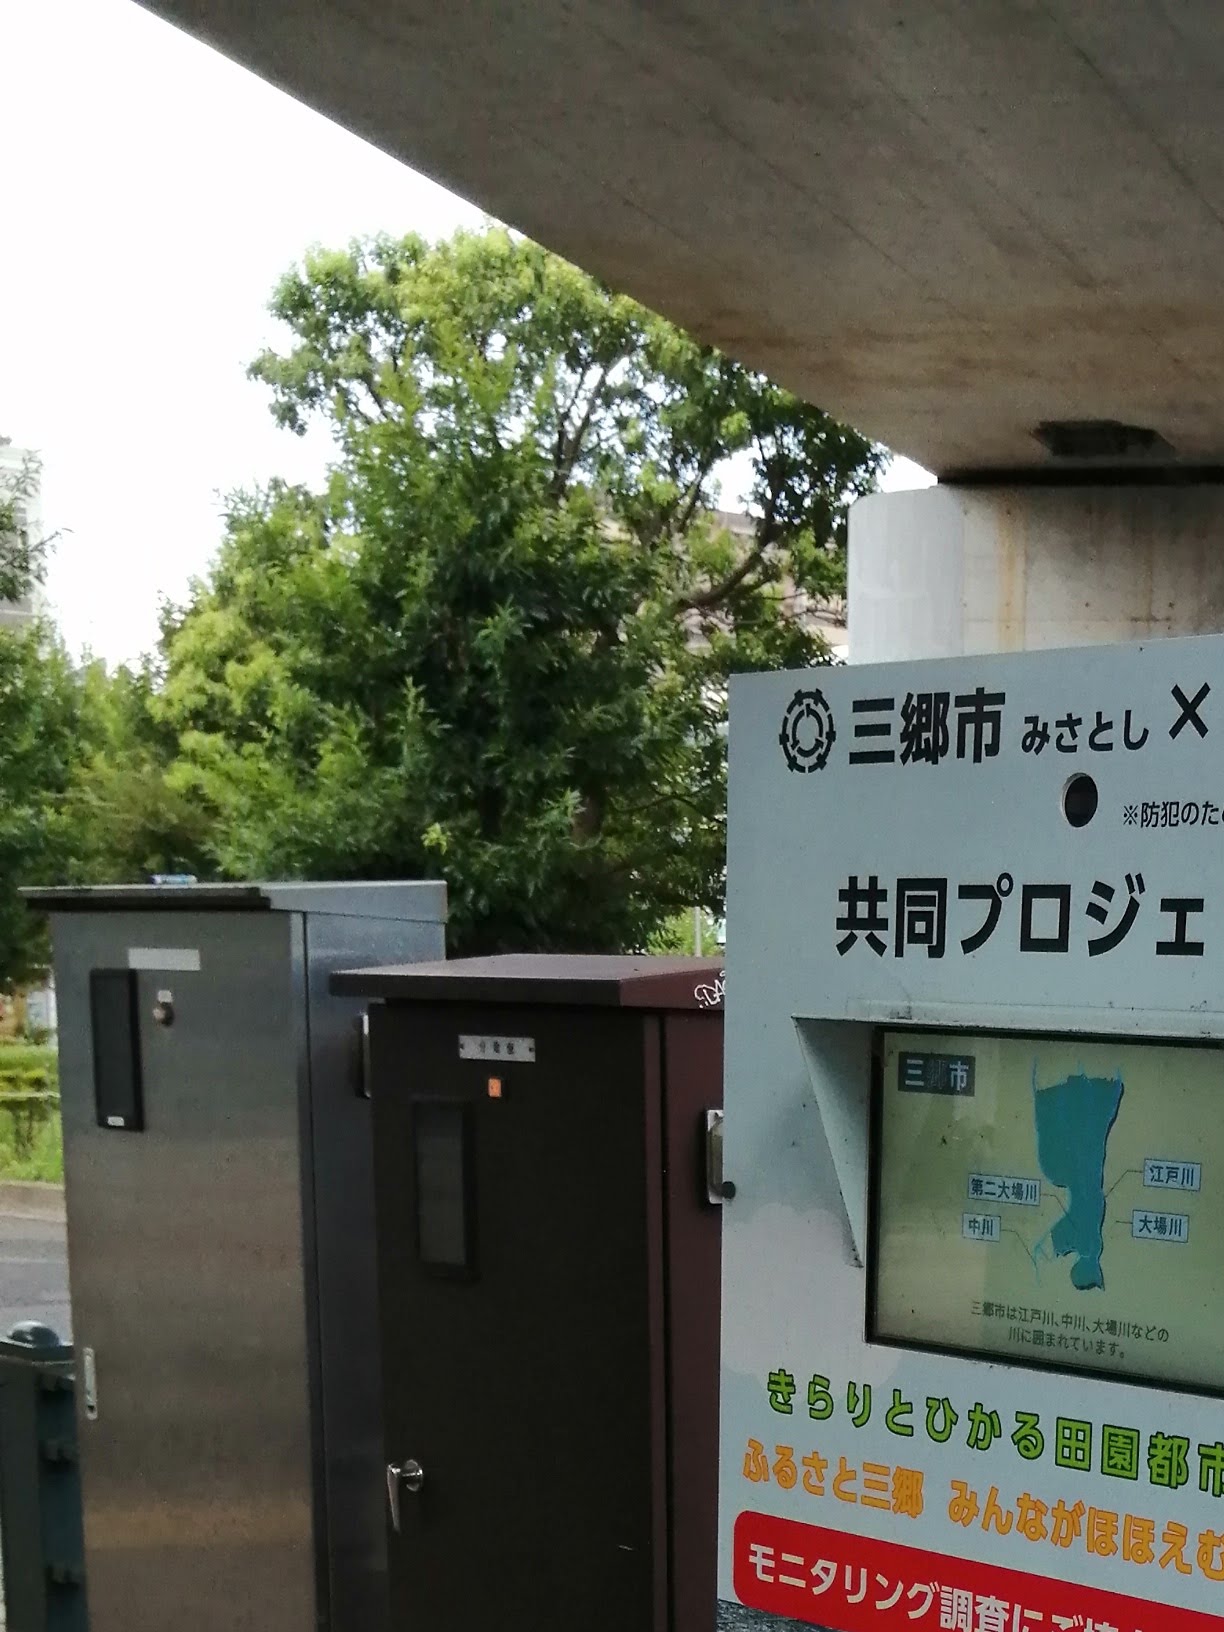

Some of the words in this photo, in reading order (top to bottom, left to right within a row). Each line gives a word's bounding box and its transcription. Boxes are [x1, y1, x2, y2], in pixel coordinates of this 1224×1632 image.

[849, 687, 1006, 765] 三郷市
[1021, 709, 1150, 756] みさとし
[1149, 1164, 1195, 1187] 江戸川
[970, 1177, 1037, 1202] 第二大場川
[968, 1217, 994, 1237] 中川
[1138, 1215, 1183, 1237] 大場川
[742, 1438, 925, 1520] ふるさと三郷
